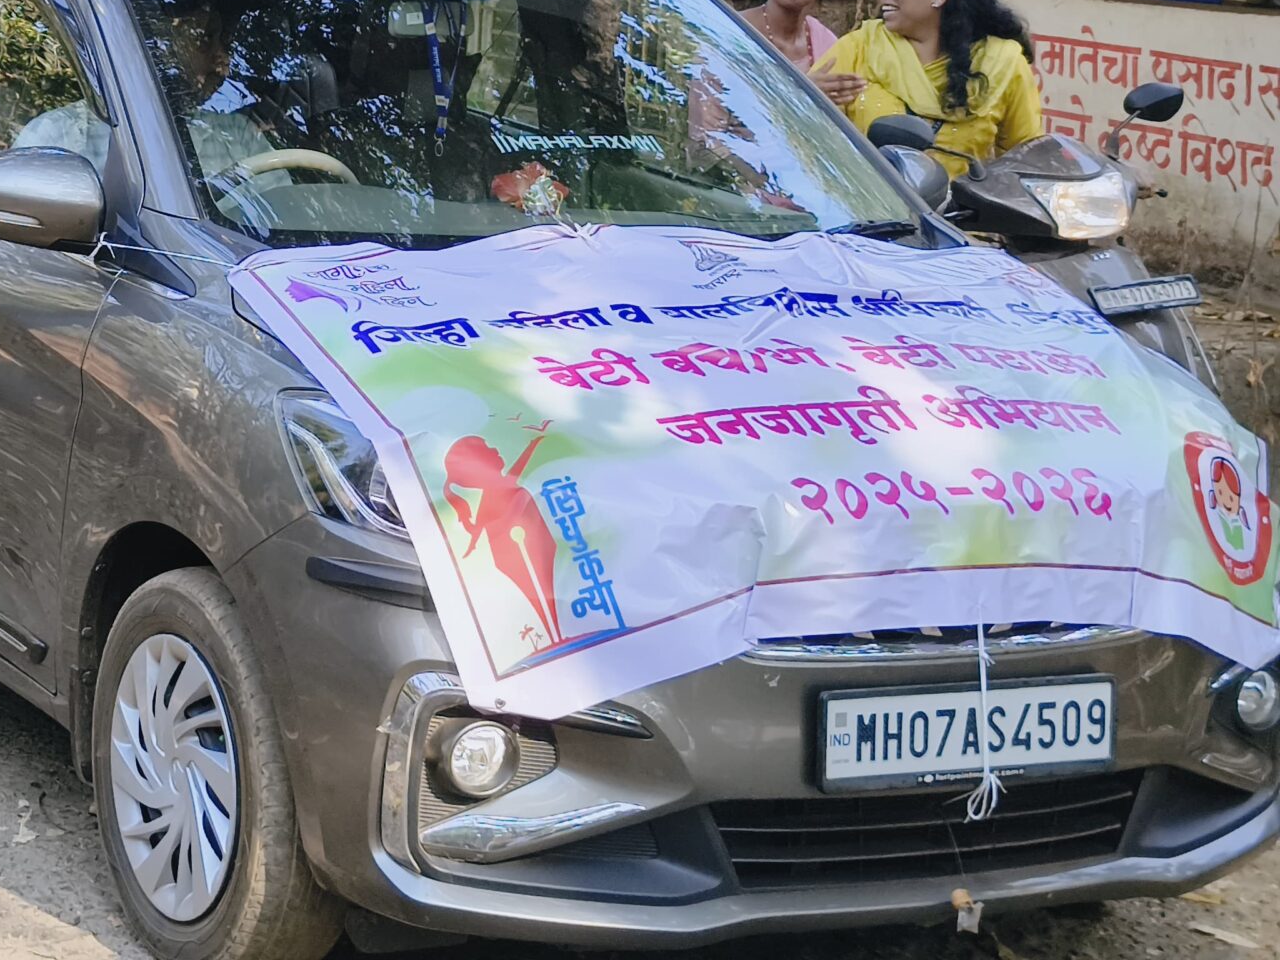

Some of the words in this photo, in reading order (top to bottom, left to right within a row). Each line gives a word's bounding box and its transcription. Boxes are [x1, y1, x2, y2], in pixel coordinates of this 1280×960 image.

[351, 317, 480, 355] जिल्हा
[611, 304, 654, 325] व
[533, 347, 650, 390] बेटी
[842, 335, 956, 370] बेटी
[656, 385, 918, 445] जनजागृती
[922, 385, 1121, 435] अभियान
[791, 467, 1113, 524] २०२५-२०२६
[829, 733, 851, 748] IND
[856, 699, 1106, 762] MH07AS4509
